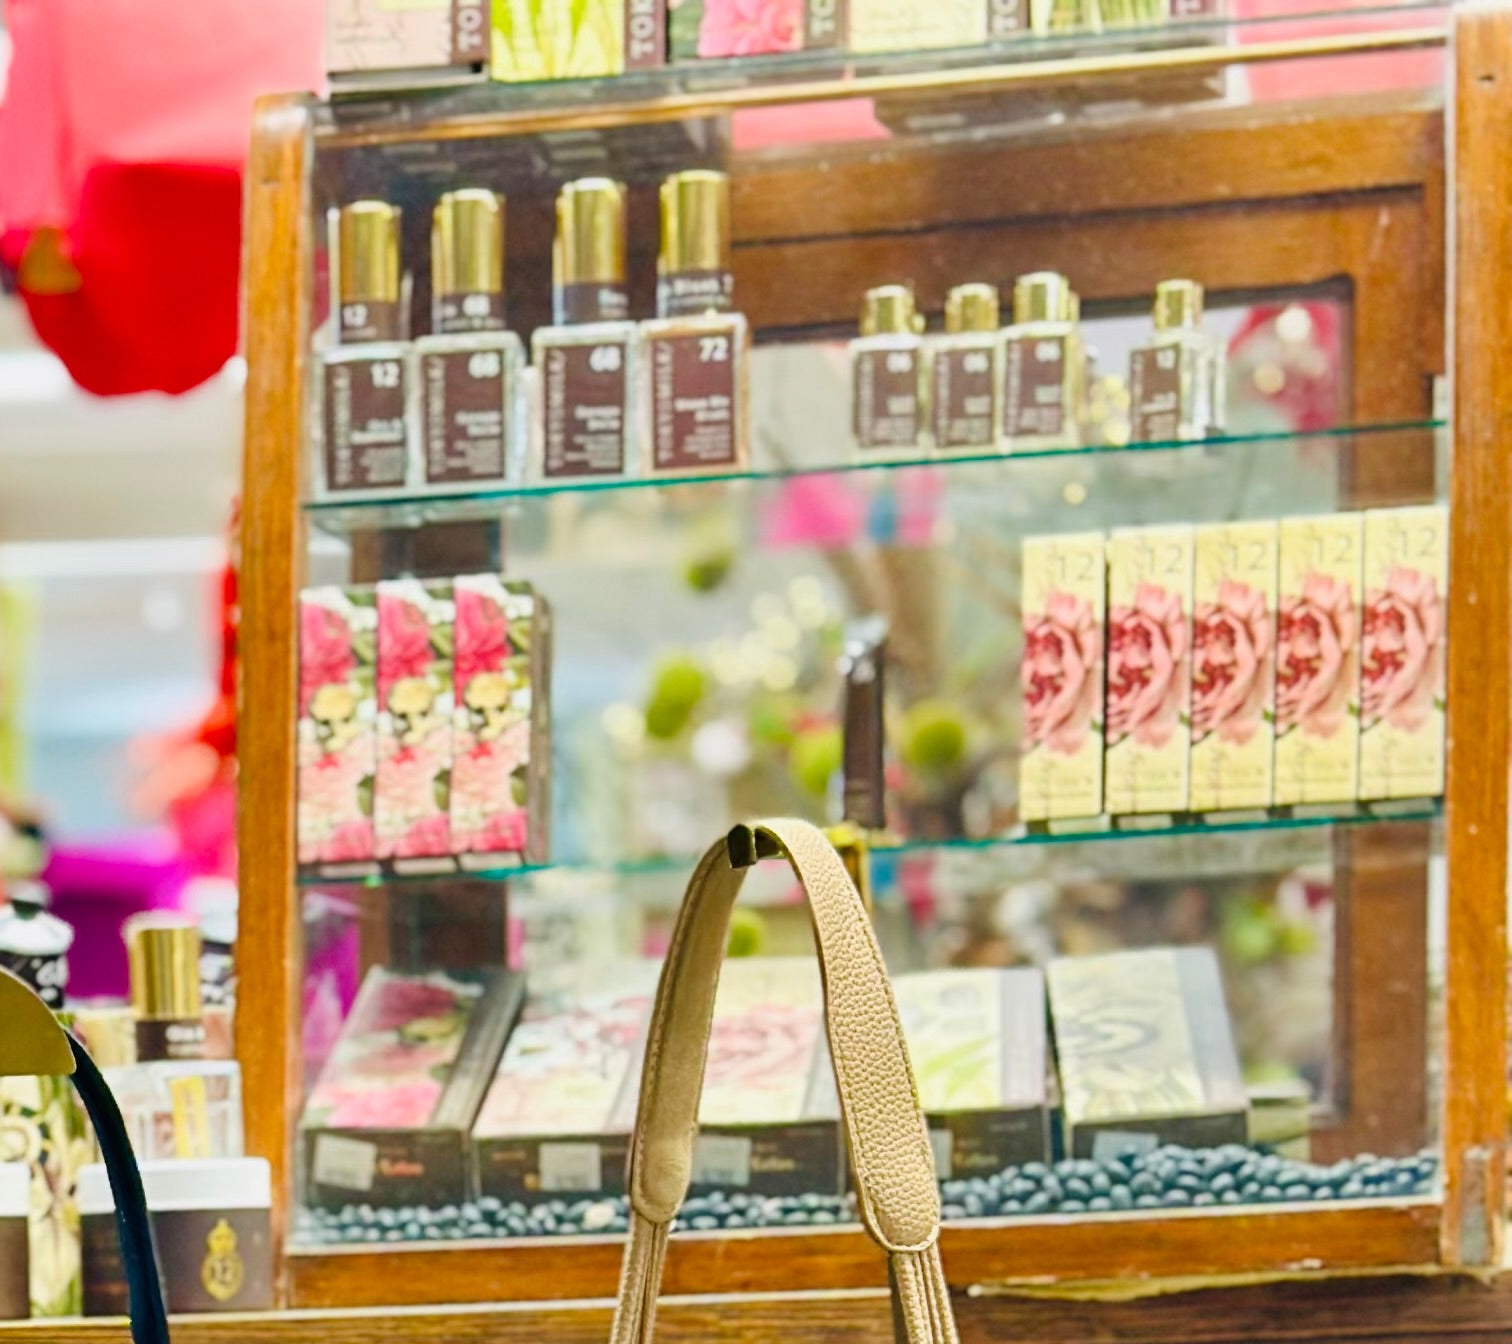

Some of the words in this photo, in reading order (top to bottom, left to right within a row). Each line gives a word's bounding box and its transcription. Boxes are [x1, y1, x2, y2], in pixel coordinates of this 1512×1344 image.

[699, 336, 729, 362] 72
[371, 361, 400, 388] 12
[1229, 542, 1266, 572] 12
[1315, 535, 1351, 565] 12
[1401, 527, 1436, 557] 12
[1058, 552, 1095, 583] 12
[1145, 545, 1182, 575] 12
